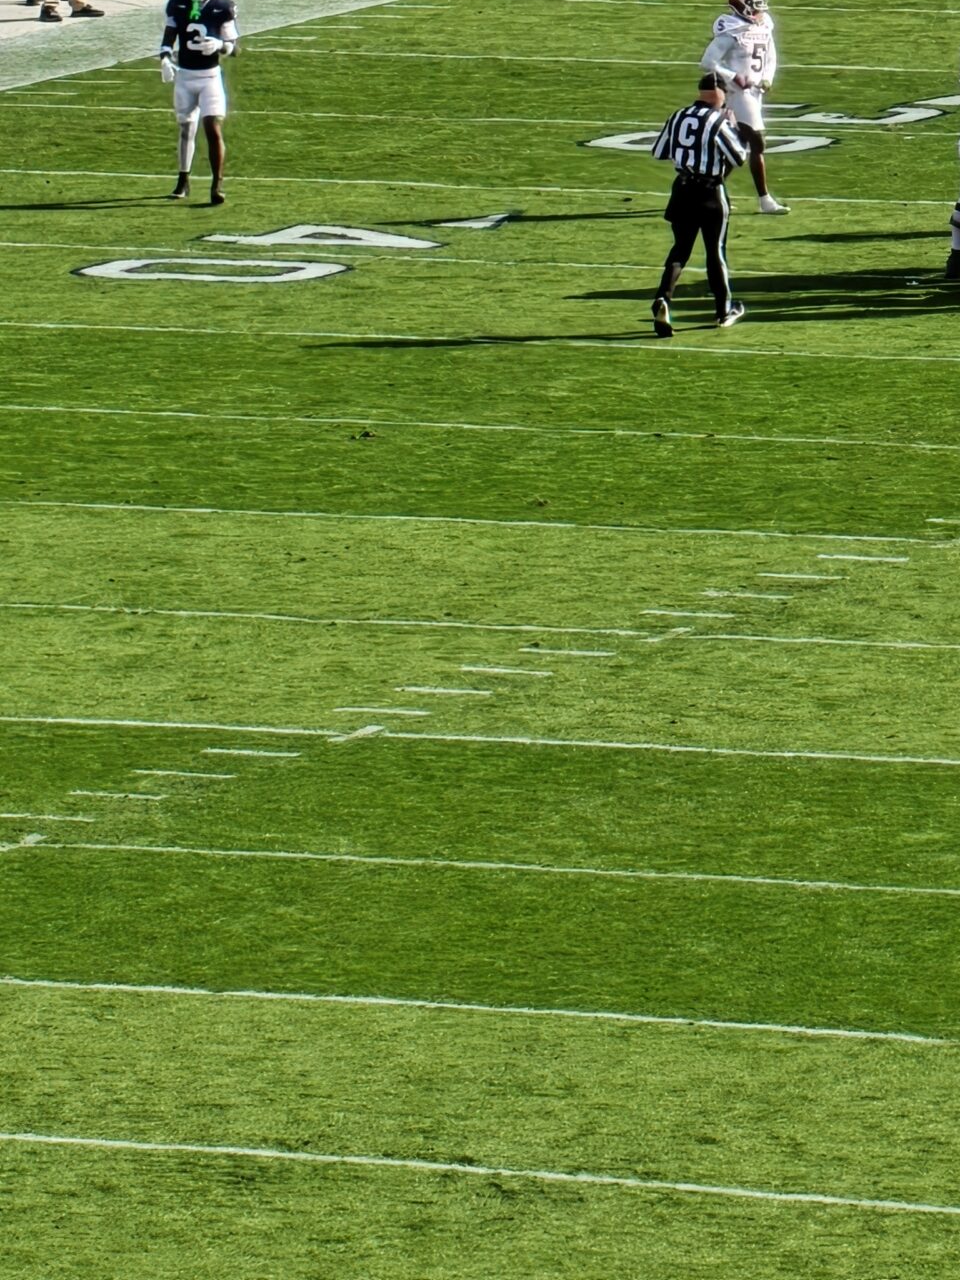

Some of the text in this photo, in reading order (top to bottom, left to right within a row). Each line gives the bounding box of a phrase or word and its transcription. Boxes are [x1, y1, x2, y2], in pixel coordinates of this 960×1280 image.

[186, 23, 208, 51] 3
[750, 43, 766, 72] 5
[678, 116, 699, 147] C
